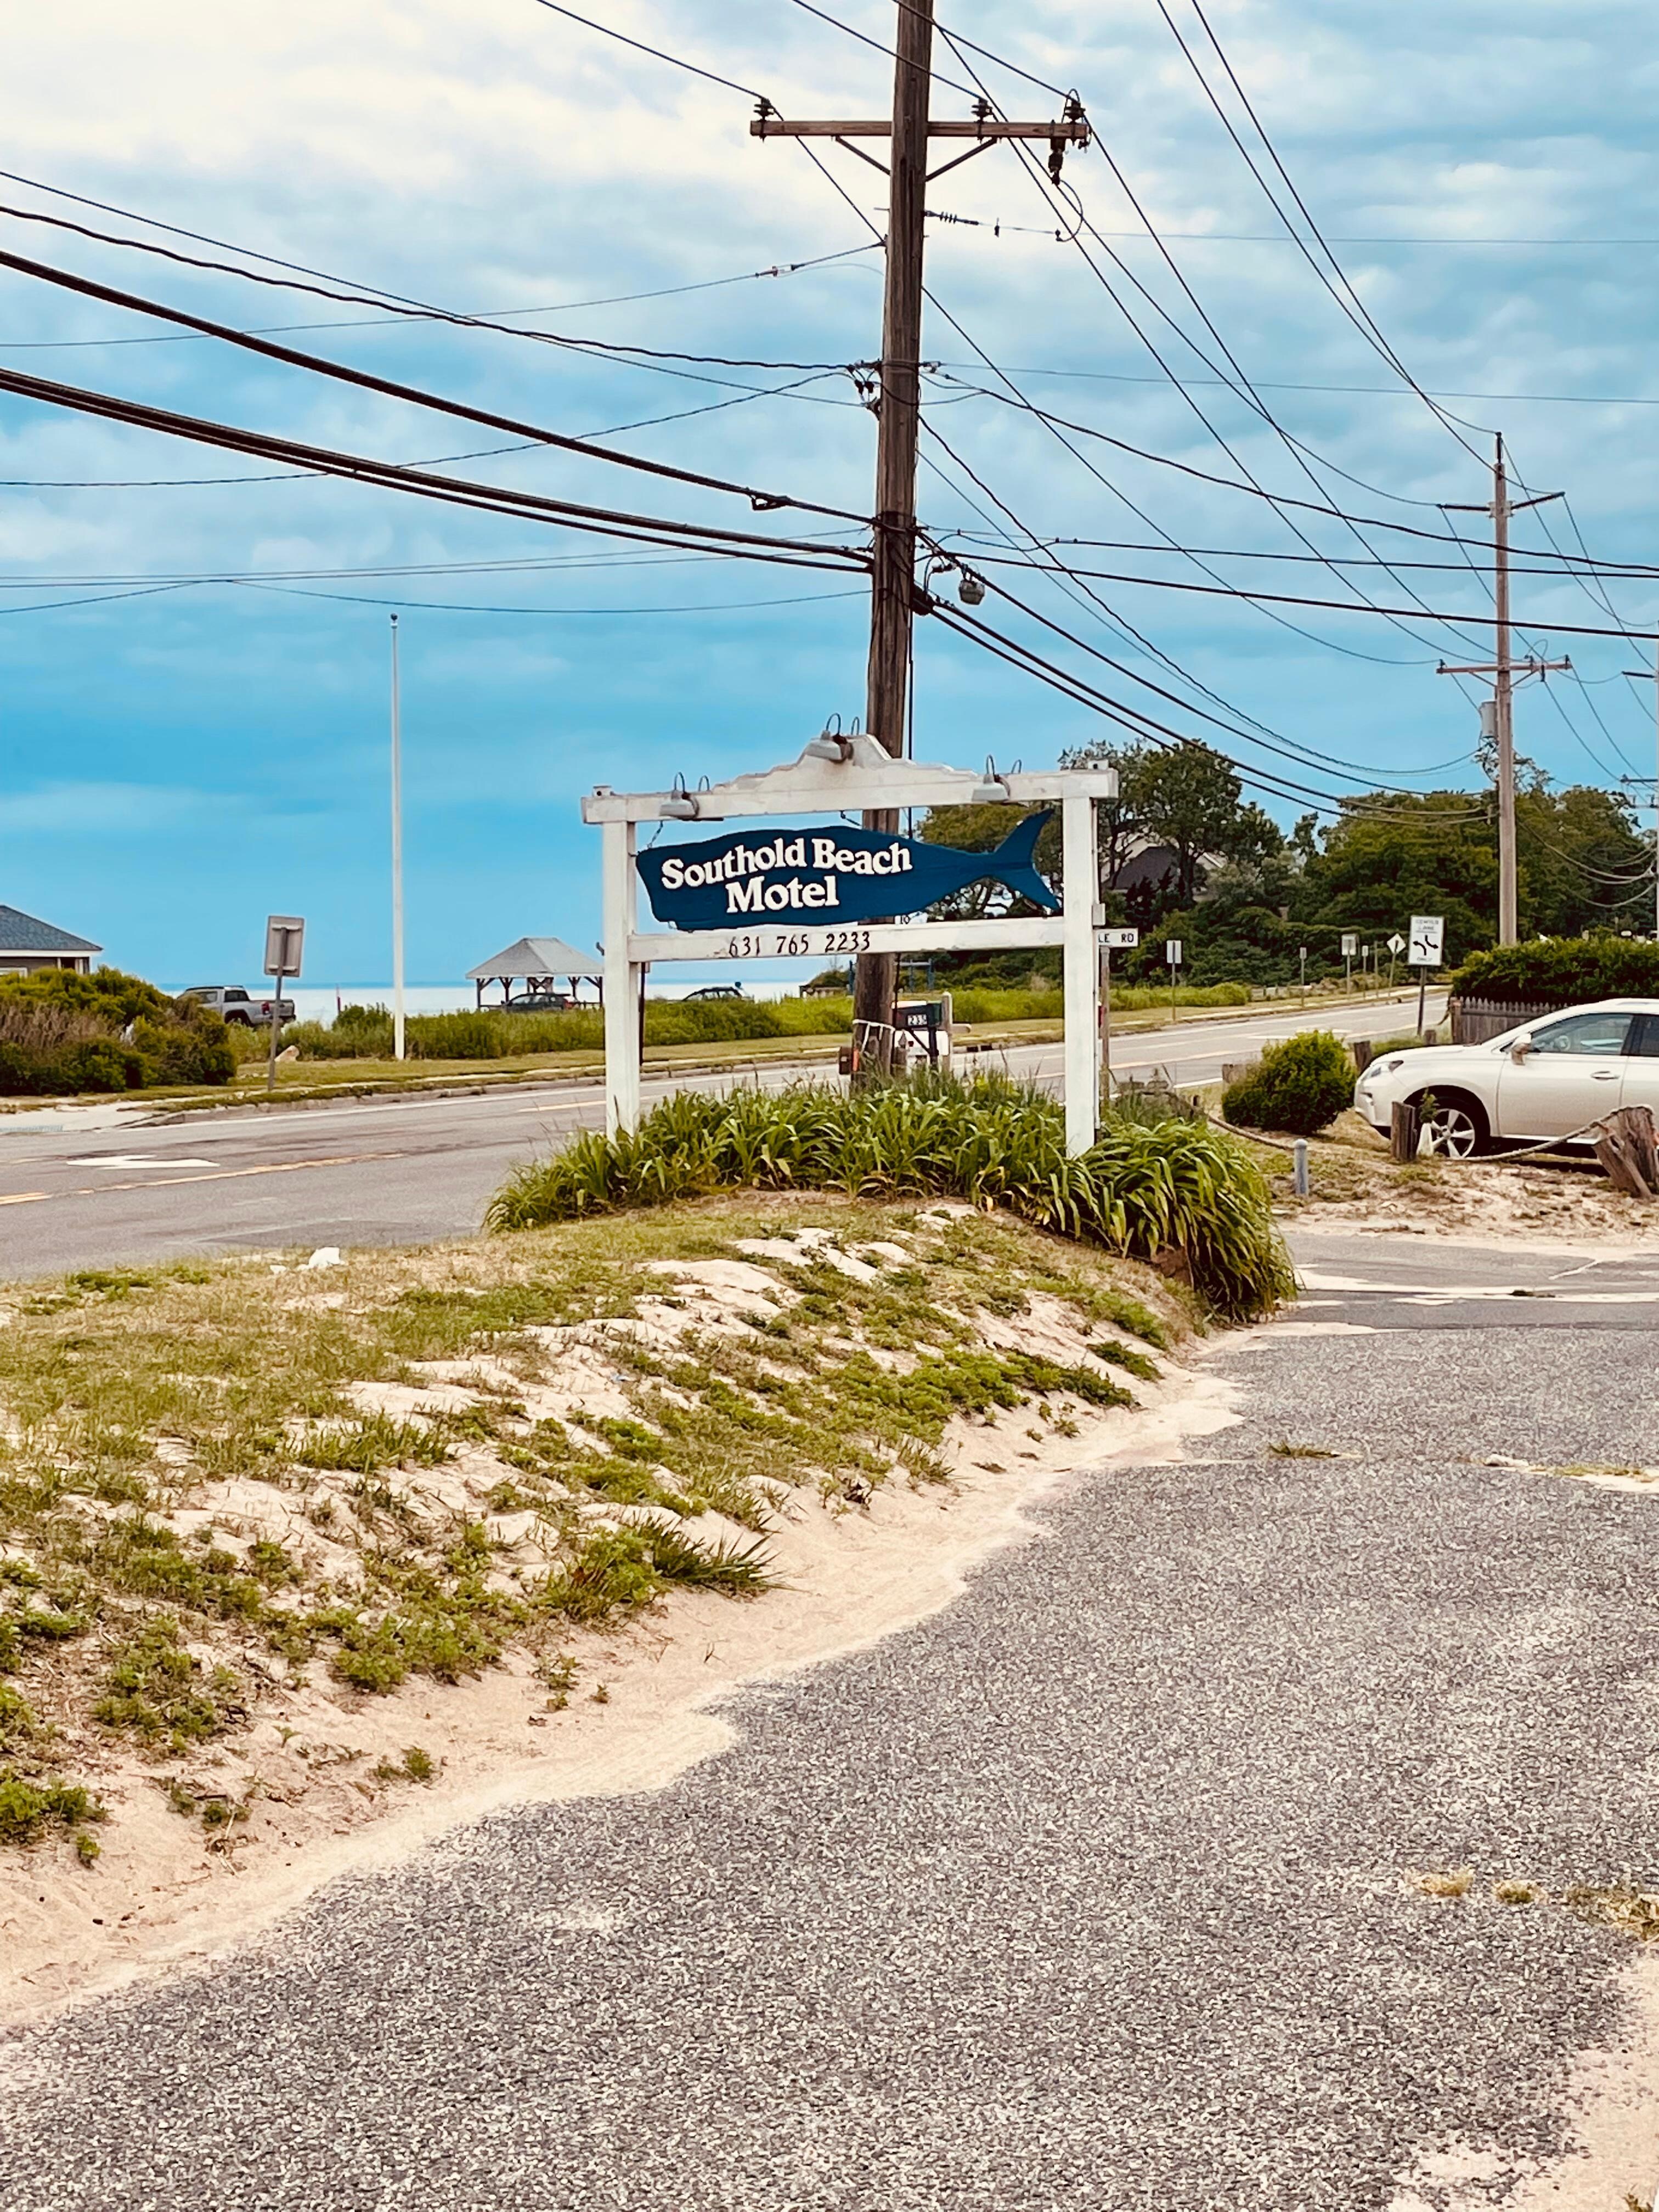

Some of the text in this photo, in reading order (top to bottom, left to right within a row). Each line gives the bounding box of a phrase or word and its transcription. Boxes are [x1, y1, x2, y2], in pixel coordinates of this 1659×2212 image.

[662, 838, 913, 889] Southold Beach
[725, 876, 839, 913] Motel
[729, 932, 870, 957] 631 765 2233
